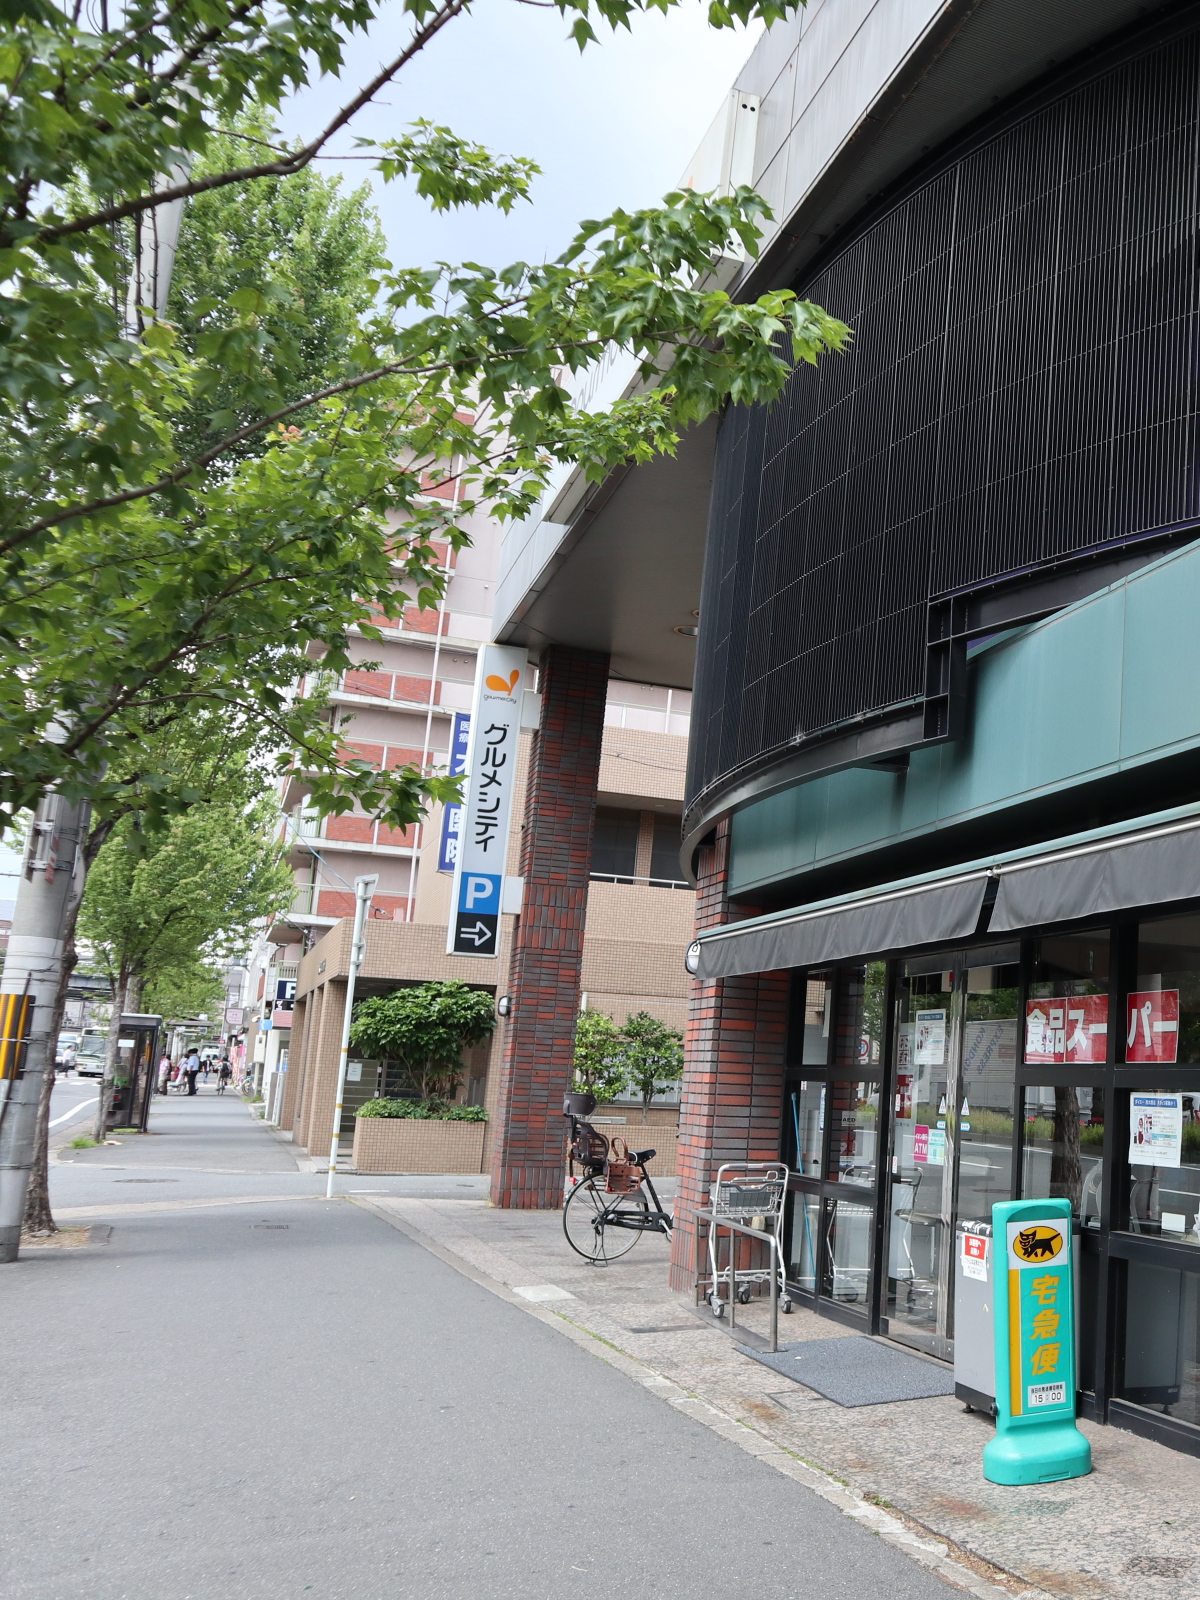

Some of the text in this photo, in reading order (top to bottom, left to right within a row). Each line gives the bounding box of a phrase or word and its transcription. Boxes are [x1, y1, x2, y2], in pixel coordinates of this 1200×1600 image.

[475, 723, 510, 852] グルメシティ
[465, 877, 494, 909] P
[914, 1142, 928, 1154] ATM
[1029, 1273, 1062, 1376] 宅急便
